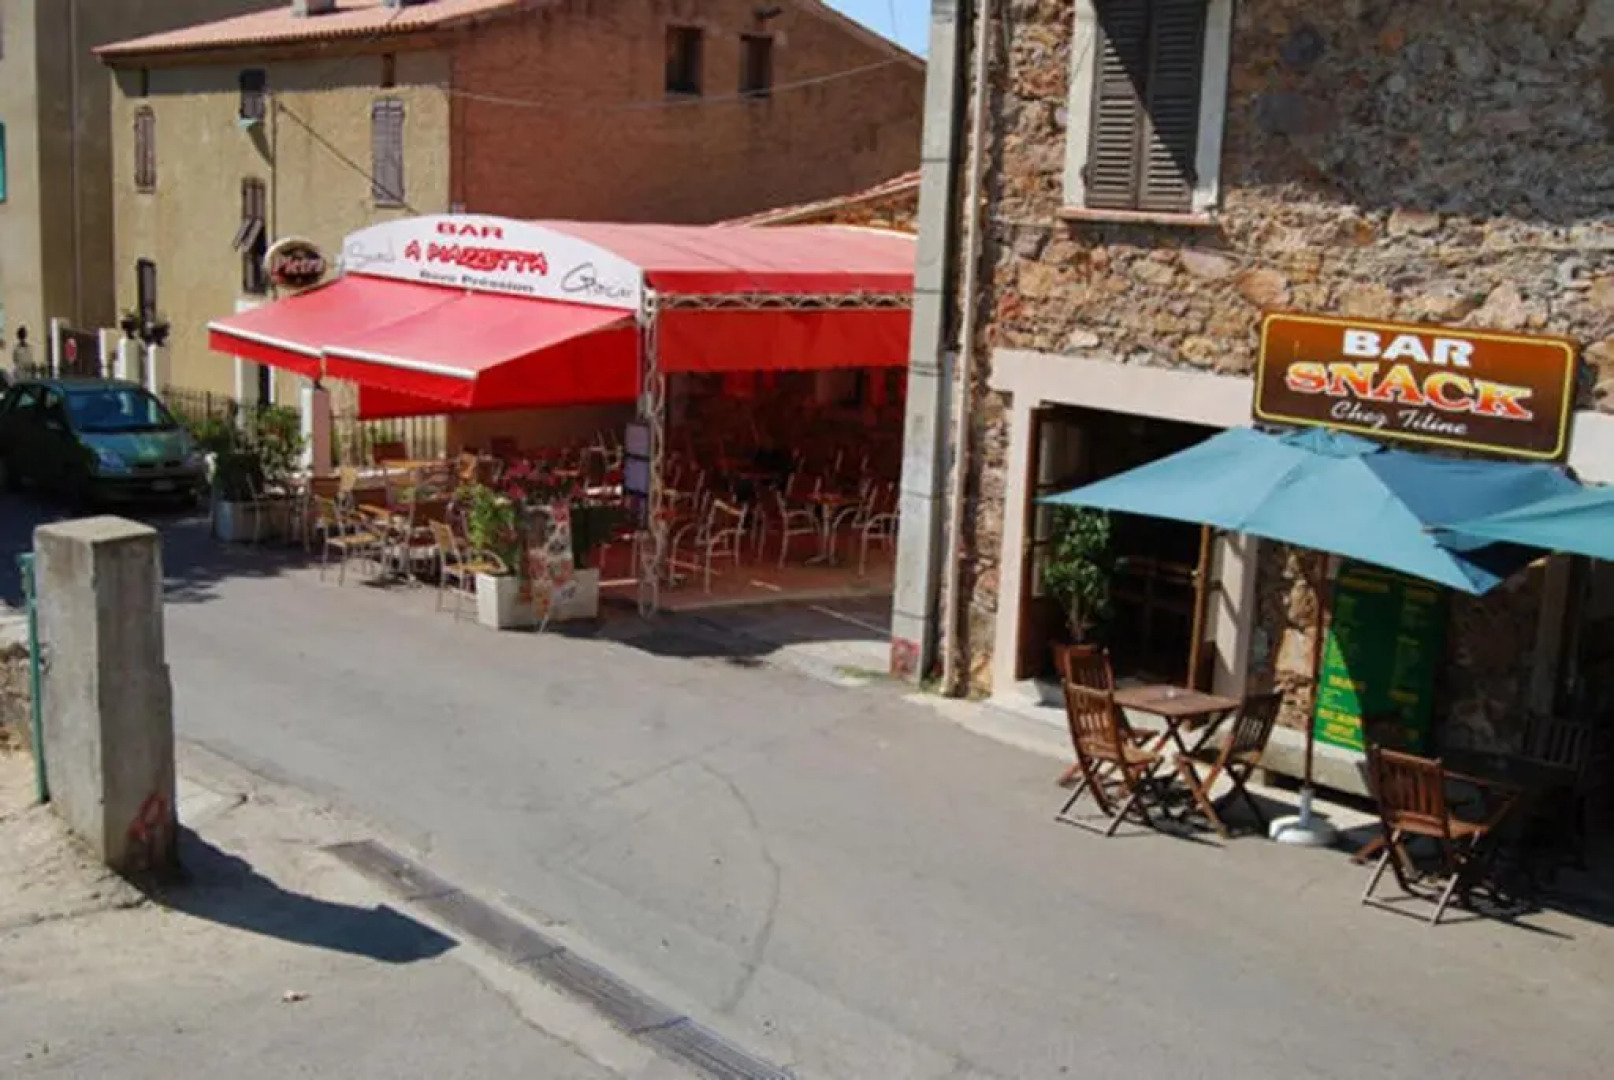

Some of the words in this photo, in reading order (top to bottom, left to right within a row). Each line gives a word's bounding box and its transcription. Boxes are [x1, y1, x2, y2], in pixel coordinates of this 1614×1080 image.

[436, 221, 504, 240] BAR
[404, 239, 422, 261] A
[1343, 328, 1475, 367] BAR
[1285, 361, 1533, 420] SNACK
[1331, 400, 1388, 429] Chez
